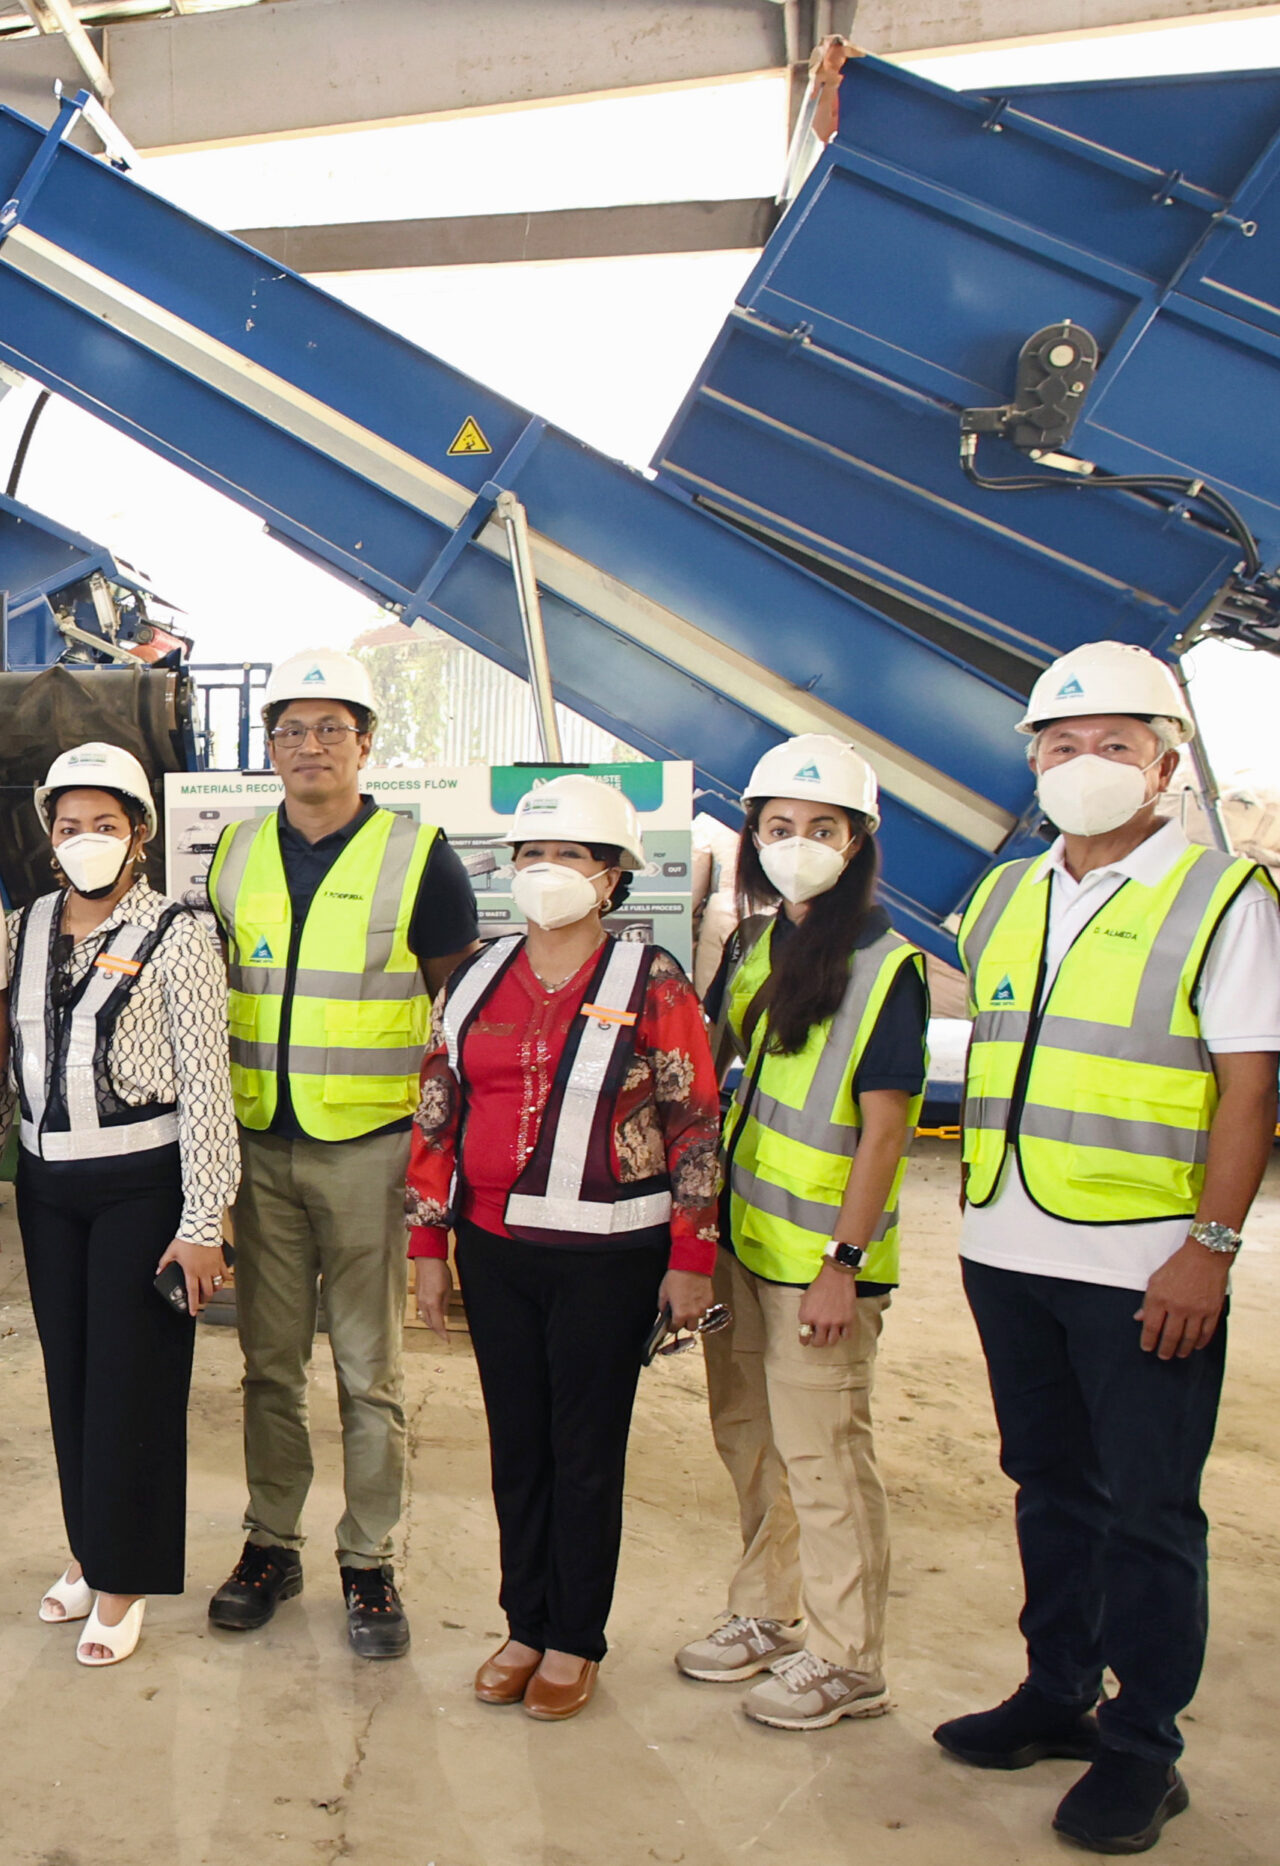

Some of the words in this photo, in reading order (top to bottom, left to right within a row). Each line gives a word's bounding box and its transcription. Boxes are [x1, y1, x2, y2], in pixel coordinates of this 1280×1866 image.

[180, 784, 243, 794] MATERIALS
[246, 783, 285, 793] RECOV
[366, 780, 421, 790] PROCESS
[424, 779, 458, 789] FLOW
